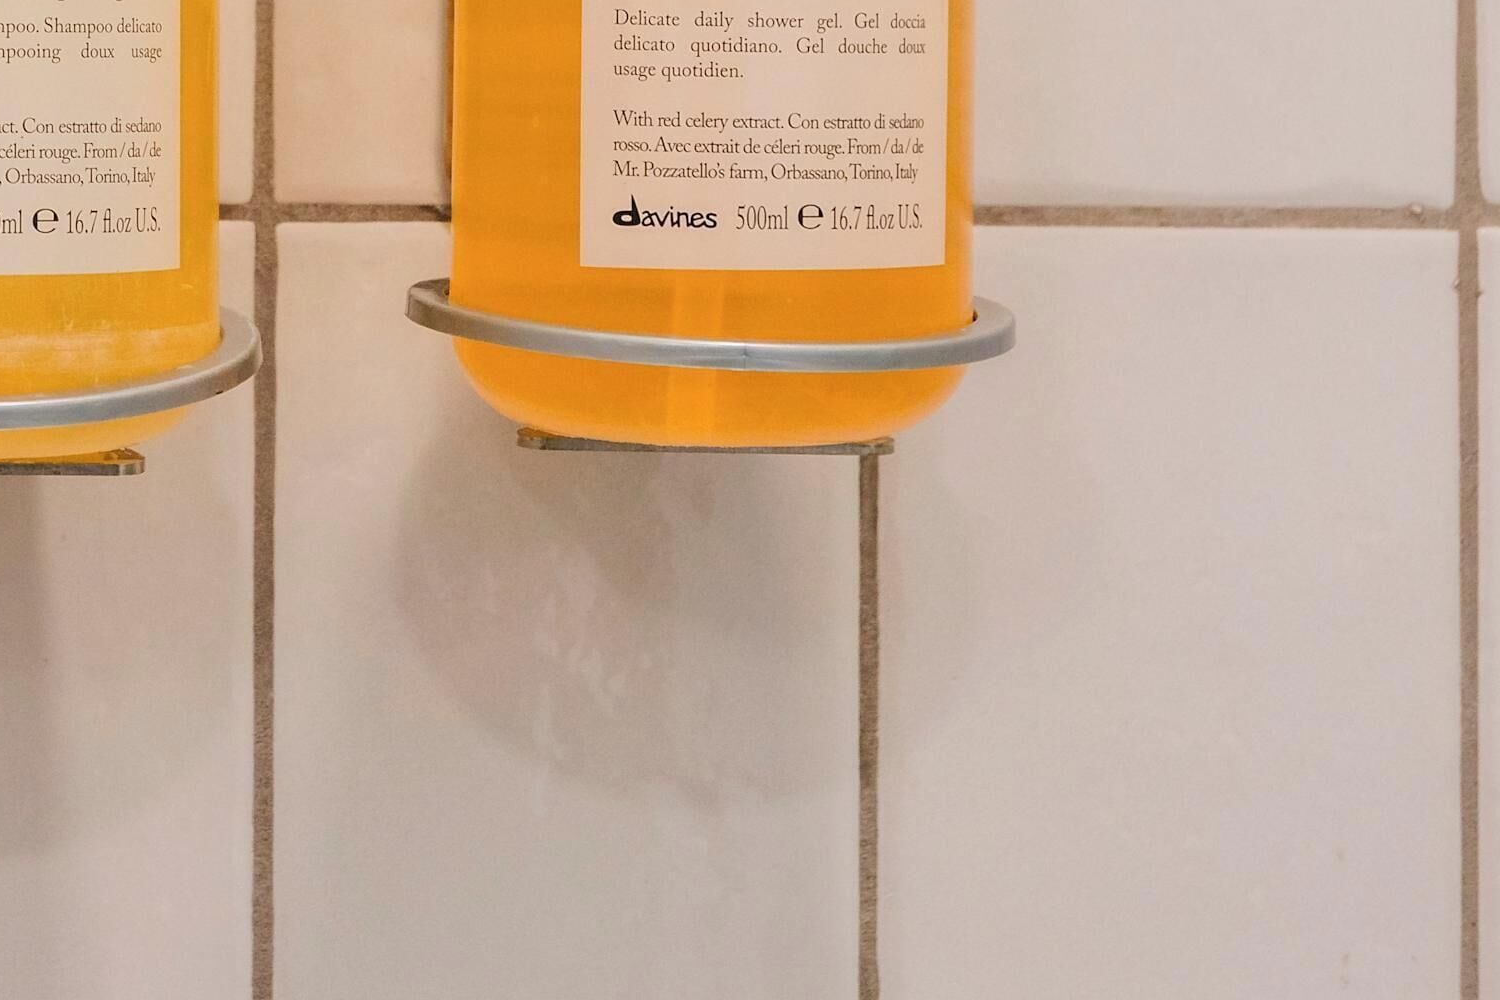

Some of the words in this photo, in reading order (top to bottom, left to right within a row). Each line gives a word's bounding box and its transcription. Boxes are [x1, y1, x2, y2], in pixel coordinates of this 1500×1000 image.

[44, 17, 112, 39] Shampoo
[117, 17, 162, 33] delicato
[615, 9, 679, 26] Delicate
[695, 11, 734, 32] daily
[748, 12, 804, 28] shower
[817, 13, 842, 33] gel.
[855, 12, 879, 28] Gel
[890, 12, 926, 29] doccia
[81, 42, 114, 58] doux
[132, 48, 162, 63] usage
[614, 34, 674, 51] delicato
[691, 37, 782, 57] quotidiano.
[797, 37, 824, 53] Gel
[838, 38, 887, 54] douche
[899, 37, 926, 54] doux
[614, 65, 656, 81] usage
[661, 61, 743, 82] quotidien.
[21, 117, 54, 135] Con
[59, 122, 106, 133] estratto
[111, 117, 122, 133] di
[126, 117, 161, 133] sedano
[613, 110, 653, 126] With
[658, 112, 680, 127] red
[686, 112, 729, 133] celery
[733, 117, 784, 129] extract.
[788, 113, 819, 129] Con
[824, 118, 871, 129] estratto
[874, 113, 885, 129] di
[889, 113, 924, 129] sedano
[39, 148, 80, 164] rouge.
[614, 141, 651, 152] rosso.
[654, 136, 691, 152] Avec
[694, 139, 740, 153] extrait
[743, 138, 760, 154] de
[764, 138, 800, 154] céleri
[804, 144, 844, 160] rouge.
[5, 168, 83, 186] Orbassano,
[85, 168, 130, 184] Torino,
[132, 167, 155, 187] Italy
[613, 160, 639, 176] Mr.
[730, 163, 767, 181] farm,
[771, 163, 848, 182] Orbassano,
[849, 163, 893, 182] Torino,
[895, 163, 918, 184] Italy
[67, 210, 98, 234] 16.7
[135, 207, 160, 232] U.S.
[613, 195, 717, 228] davines
[736, 205, 788, 230] 500ml
[831, 206, 862, 230] 16.7
[898, 203, 922, 229] U.S.
